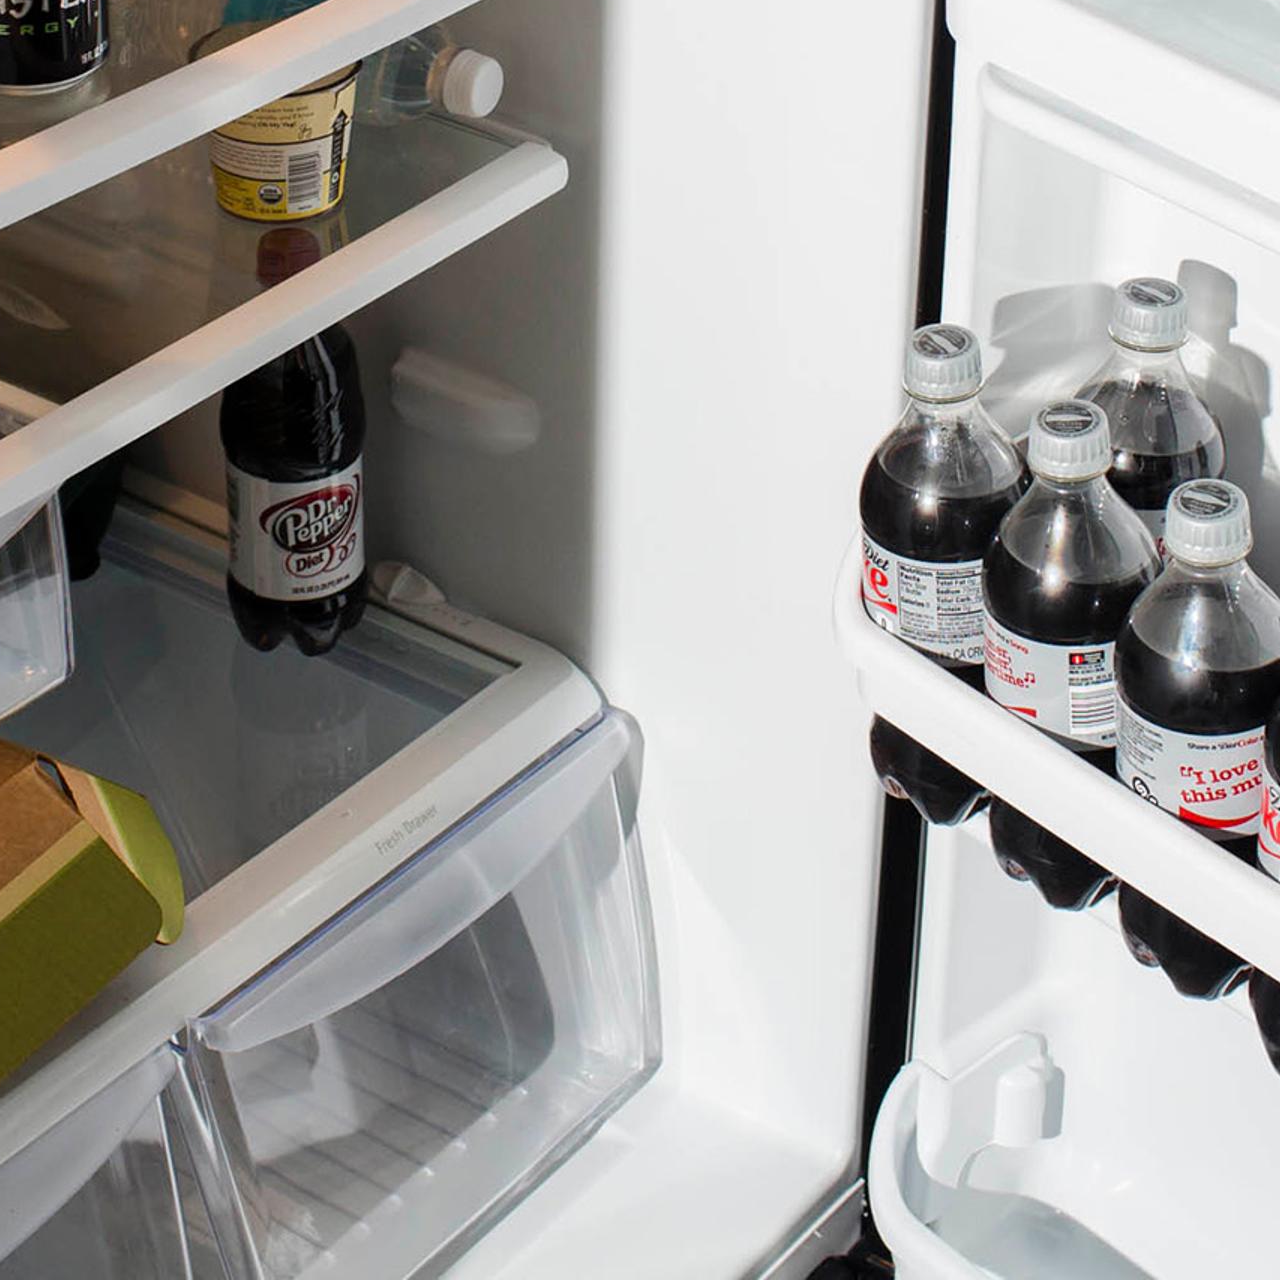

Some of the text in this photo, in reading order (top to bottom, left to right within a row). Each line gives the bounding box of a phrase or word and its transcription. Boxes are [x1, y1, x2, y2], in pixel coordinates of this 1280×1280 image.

[307, 496, 337, 521] Dr
[285, 496, 352, 548] Pepper
[295, 551, 324, 572] Diet
[863, 539, 889, 571] Diet
[1209, 758, 1259, 784] love
[1180, 788, 1227, 804] this
[373, 804, 438, 857] Fresh Drawer
